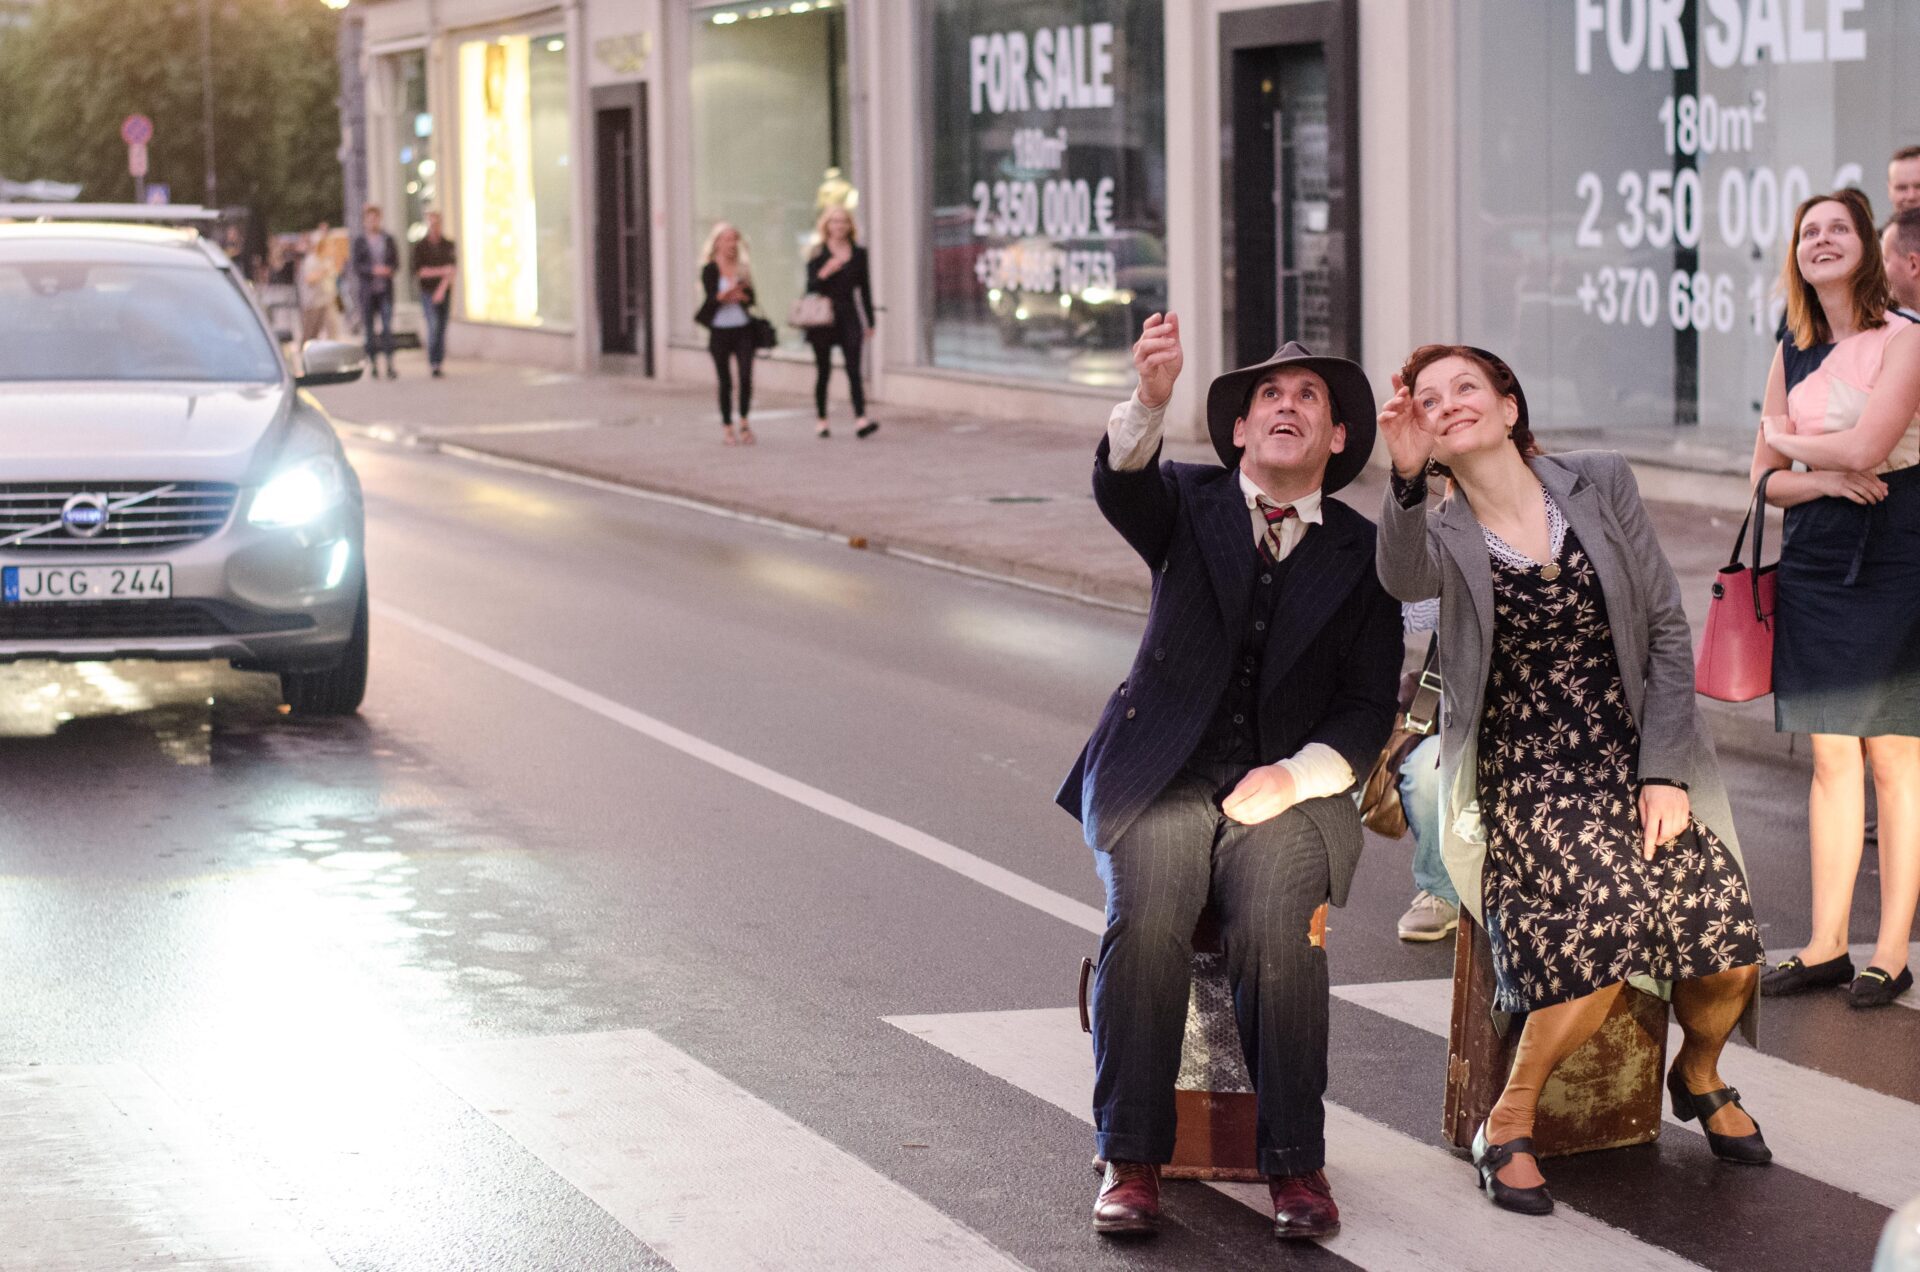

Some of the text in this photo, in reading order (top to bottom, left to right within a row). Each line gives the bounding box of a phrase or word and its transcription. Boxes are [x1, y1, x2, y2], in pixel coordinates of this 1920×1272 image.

[969, 23, 1114, 114] FOR SALE
[1575, 0, 1867, 75] FOR SALE
[993, 179, 1038, 236] 350
[1042, 178, 1091, 237] 000
[1094, 177, 1115, 238] €
[1575, 171, 1604, 247] 2
[1616, 167, 1701, 249] 350
[1577, 267, 1658, 326] +370
[1668, 269, 1735, 333] 686
[24, 569, 164, 596] JCG 244
